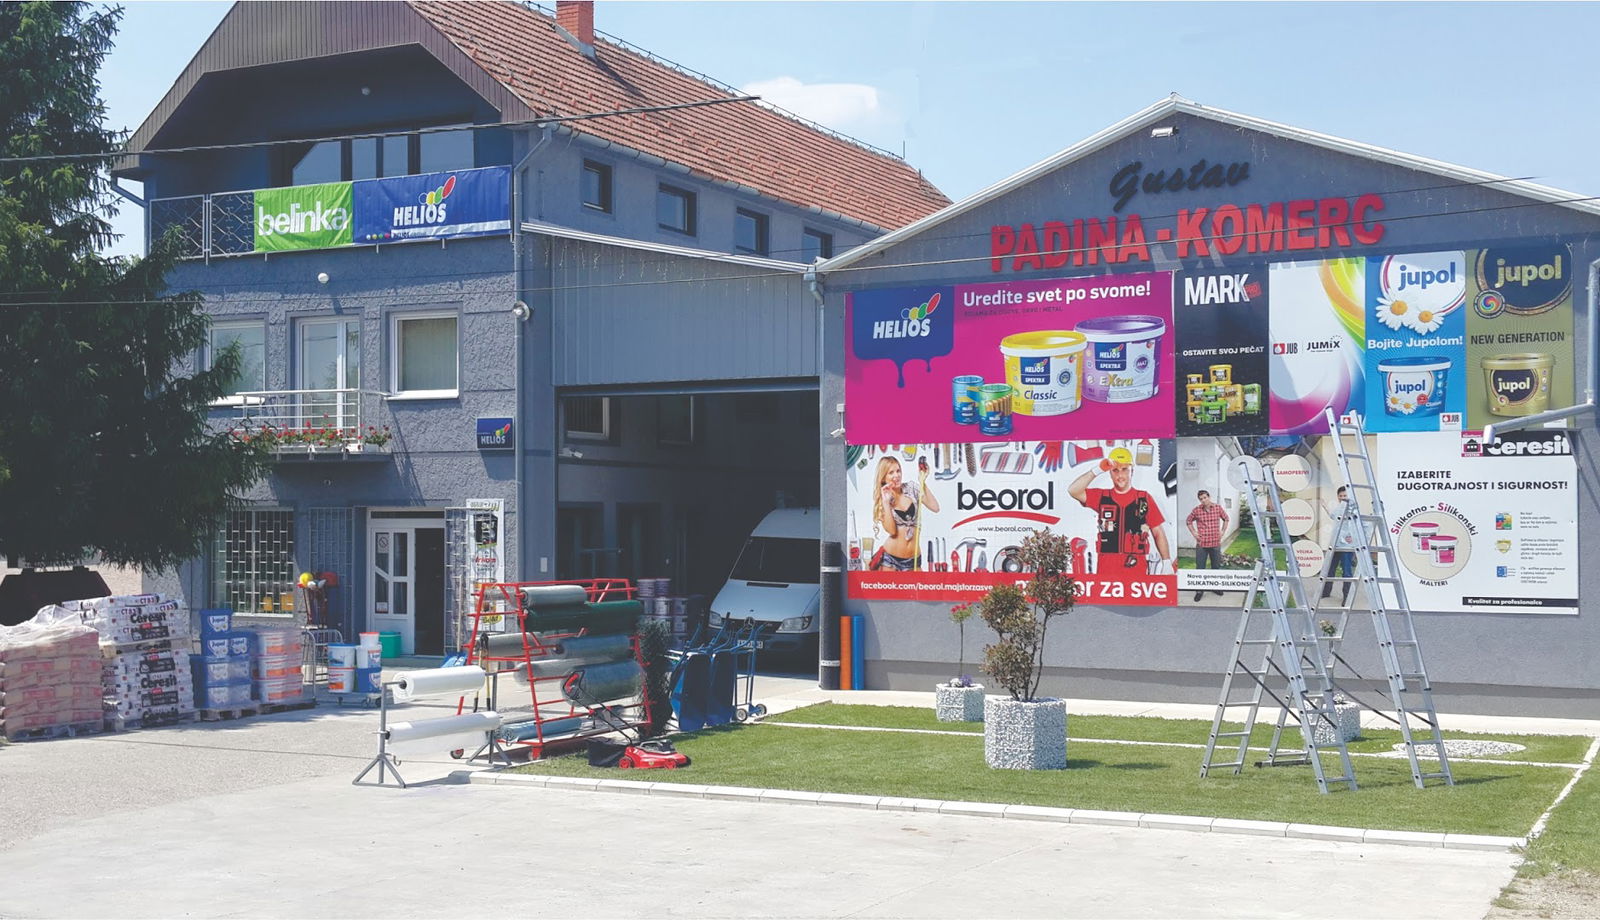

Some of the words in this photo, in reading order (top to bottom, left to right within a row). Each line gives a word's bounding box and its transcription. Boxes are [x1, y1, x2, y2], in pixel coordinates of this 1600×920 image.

[1110, 159, 1249, 212] Gustav
[258, 201, 348, 236] belinka
[393, 203, 447, 227] HELIOS
[991, 214, 1149, 272] PADINA
[1177, 193, 1385, 259] KOMERC
[1398, 262, 1456, 291] jupol
[1494, 255, 1562, 289] jupol
[963, 290, 1023, 307] Uredite
[1026, 288, 1063, 303] svet
[1066, 288, 1087, 305] po
[1089, 280, 1151, 300] svome!
[1184, 273, 1250, 306] MARK
[873, 319, 931, 339] HELIOS
[1367, 336, 1402, 350] Bojite
[1406, 335, 1463, 349] Jupolom!
[1470, 334, 1495, 345] NEW
[1498, 332, 1565, 344] GENERATION
[1183, 348, 1217, 356] OSTAVITE
[1240, 345, 1264, 353] PEČAT
[1286, 342, 1298, 354] JUB
[1395, 379, 1426, 394] jupol
[1497, 377, 1531, 393] jupol
[1024, 389, 1058, 400] Classic
[481, 435, 506, 445] HELIOS
[1397, 470, 1452, 479] IZABERITE
[1397, 481, 1488, 490] DUGOTRAJNOST
[1497, 481, 1568, 490] SIGURNOST!
[957, 481, 1054, 510] beorol
[1391, 505, 1427, 535] Silikatno
[1437, 502, 1479, 536] Silikonski
[1100, 581, 1124, 598] za
[1130, 582, 1168, 598] sve
[141, 674, 177, 689] Ceresit
